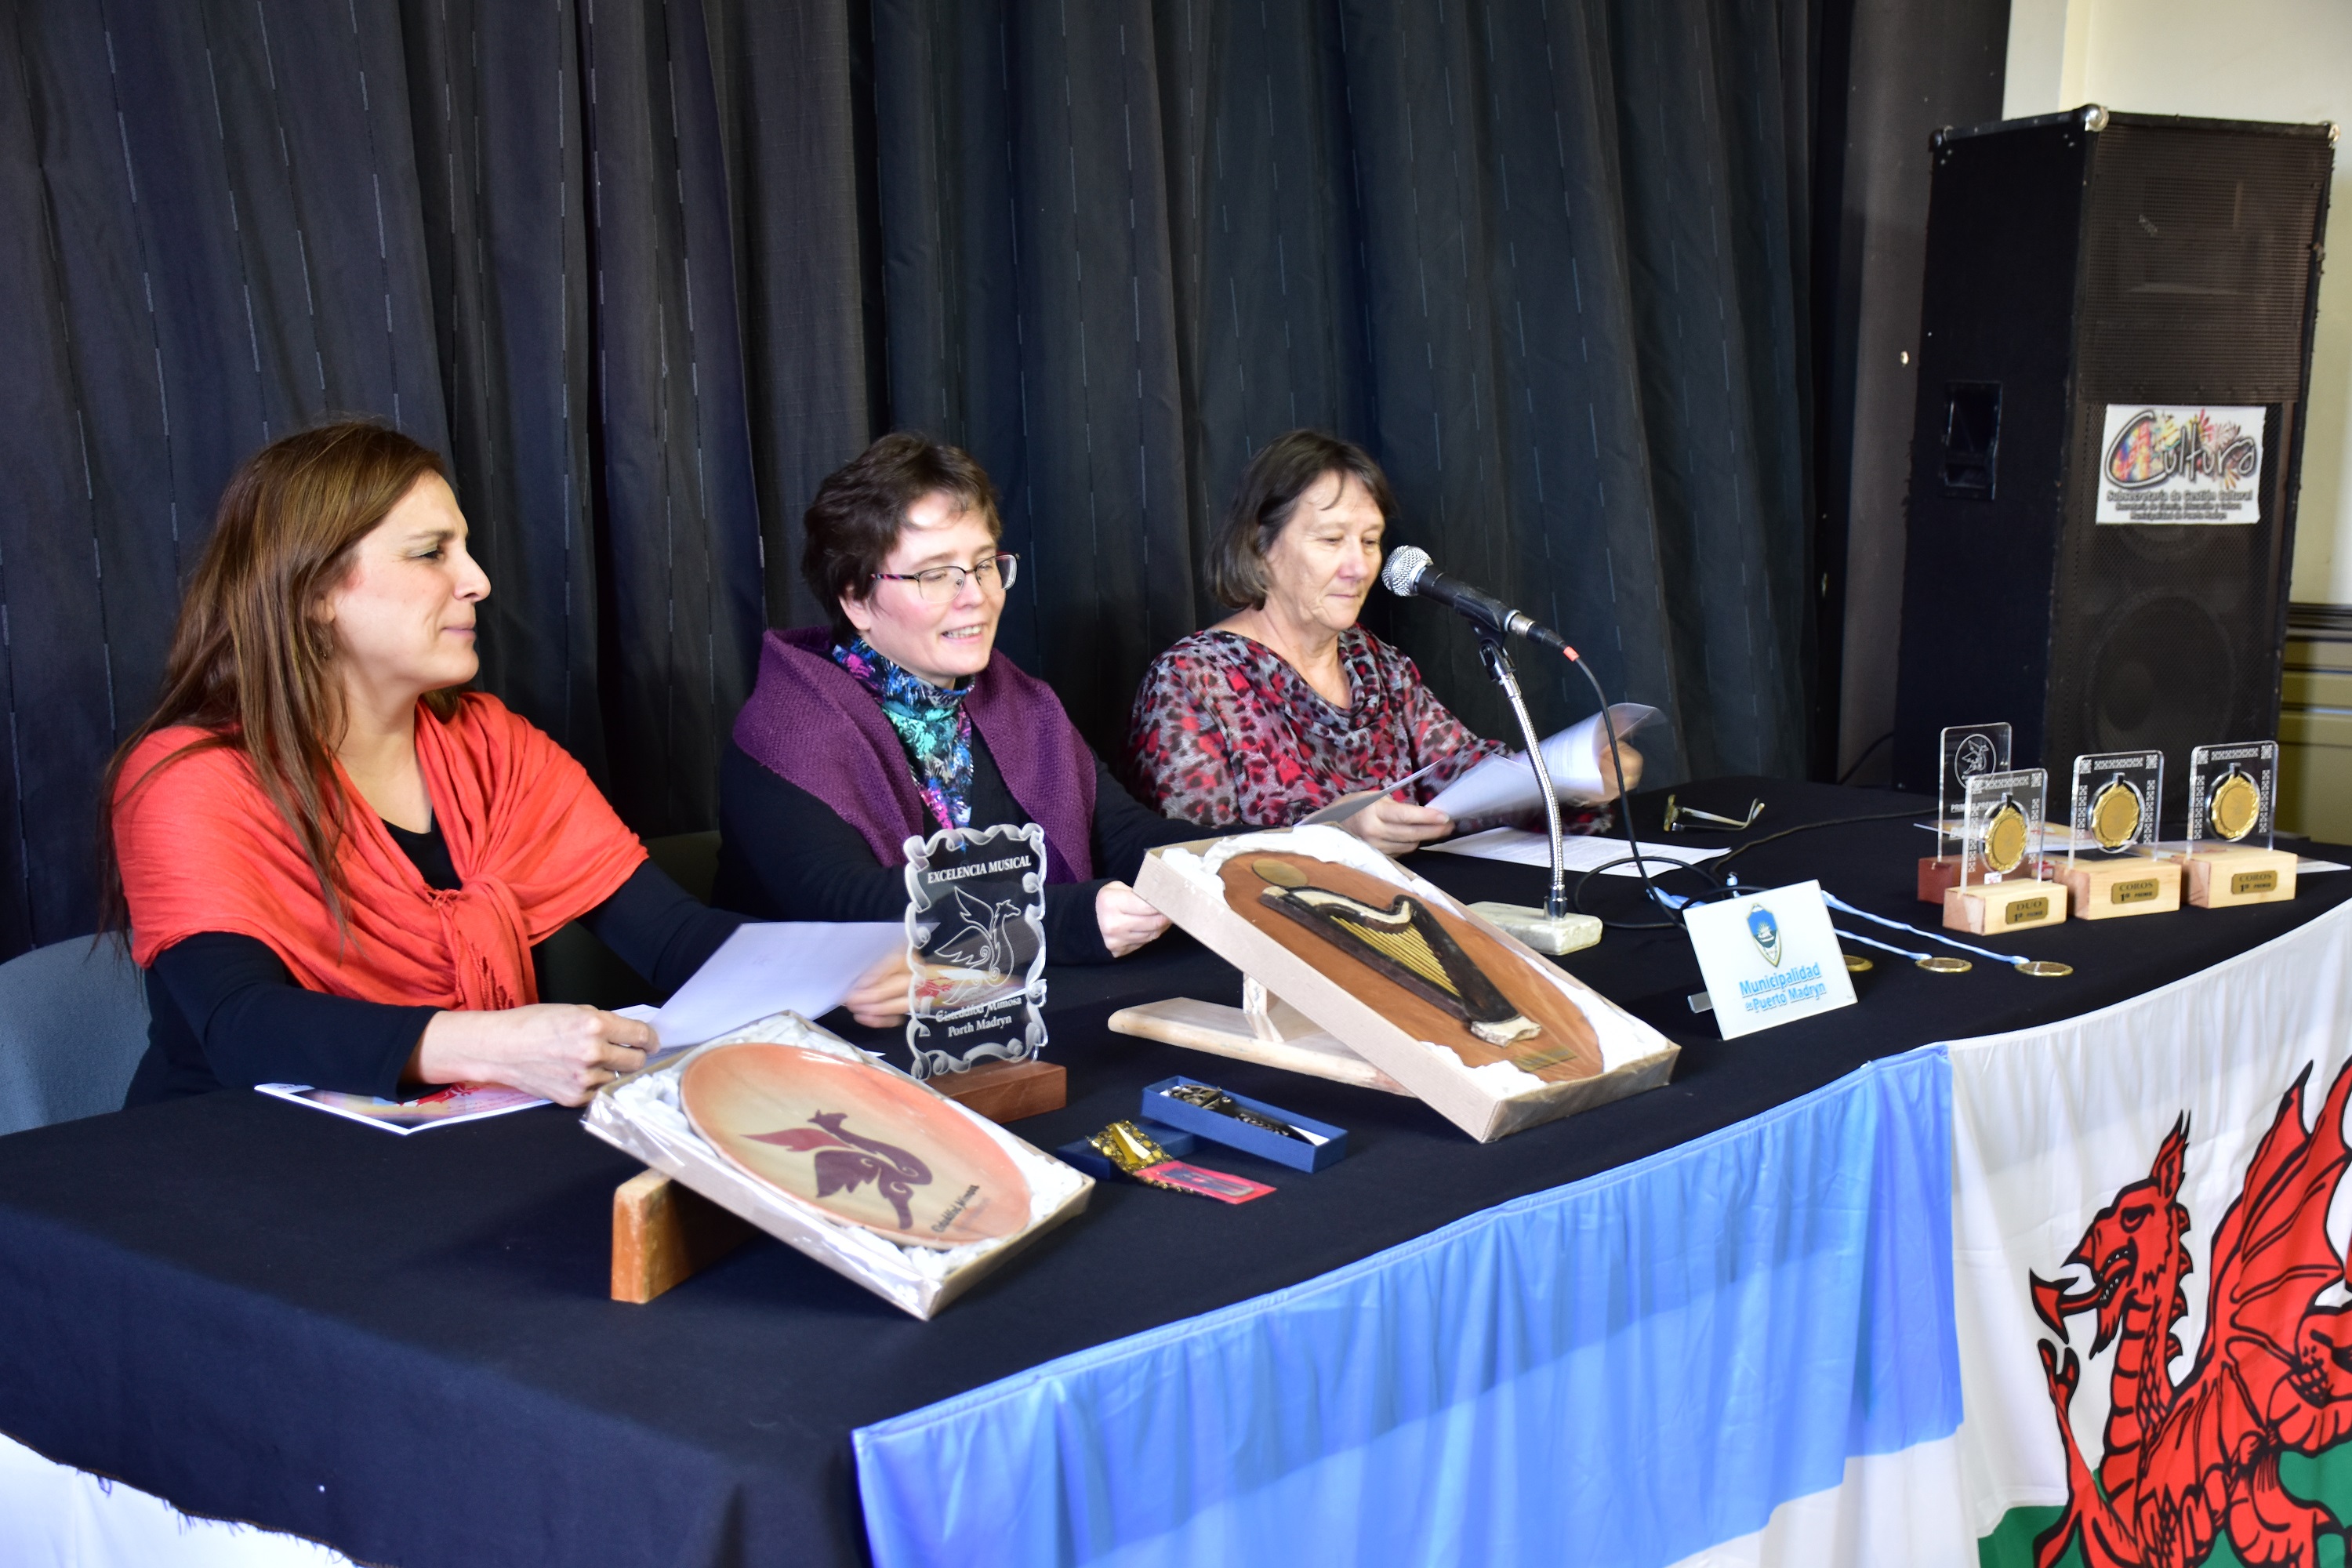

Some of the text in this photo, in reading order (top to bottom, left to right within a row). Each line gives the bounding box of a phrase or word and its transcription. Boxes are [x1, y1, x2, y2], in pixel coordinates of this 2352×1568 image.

[2105, 408, 2257, 489] Cultura
[927, 855, 1032, 884] EXCELENCIA MUSICAL
[2016, 901, 2042, 910] DUO
[1739, 961, 1822, 998] Municipalidad
[984, 996, 1022, 1018] Mimosa
[1752, 993, 1787, 1013] Puerto
[1788, 982, 1827, 1004] Madryn
[948, 1015, 1013, 1037] Porth Madryn
